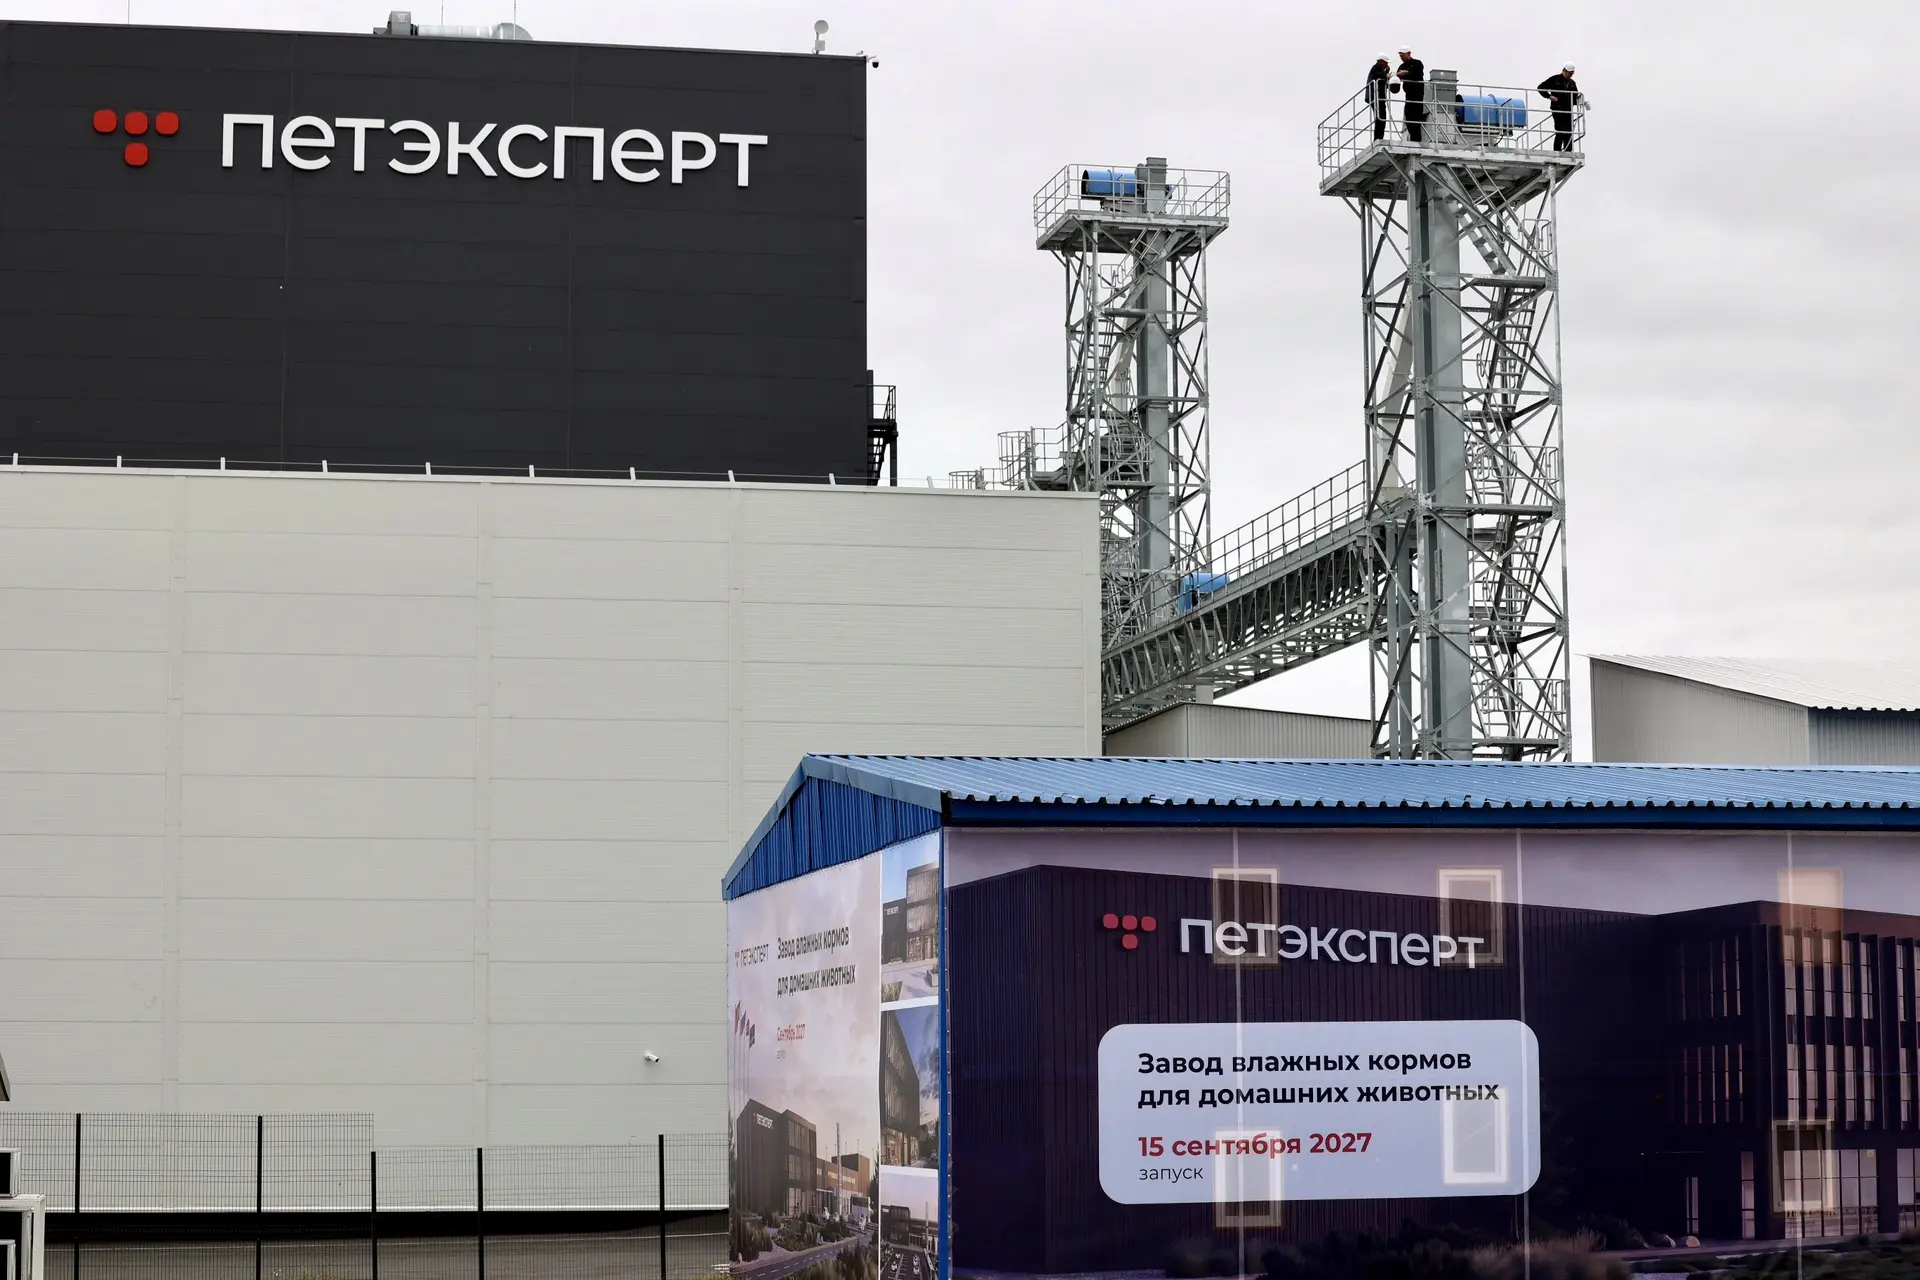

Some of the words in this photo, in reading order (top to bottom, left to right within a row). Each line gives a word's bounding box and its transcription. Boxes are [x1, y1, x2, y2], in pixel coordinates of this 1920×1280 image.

[777, 937, 796, 960] Завод
[796, 931, 823, 955] влажных
[823, 926, 850, 954] кормов
[777, 976, 789, 998] для
[789, 969, 820, 996] домашних
[820, 964, 856, 988] животных
[1137, 1053, 1224, 1076] Завод
[1232, 1054, 1361, 1073] влажных
[1368, 1053, 1472, 1075] кормов
[1137, 1089, 1190, 1109] для
[1198, 1086, 1350, 1108] домашних
[1356, 1084, 1500, 1102] животных
[1138, 1136, 1165, 1157] 15
[1172, 1132, 1301, 1160] сентября
[1309, 1132, 1373, 1154] 2027
[1139, 1167, 1204, 1184] запуск
